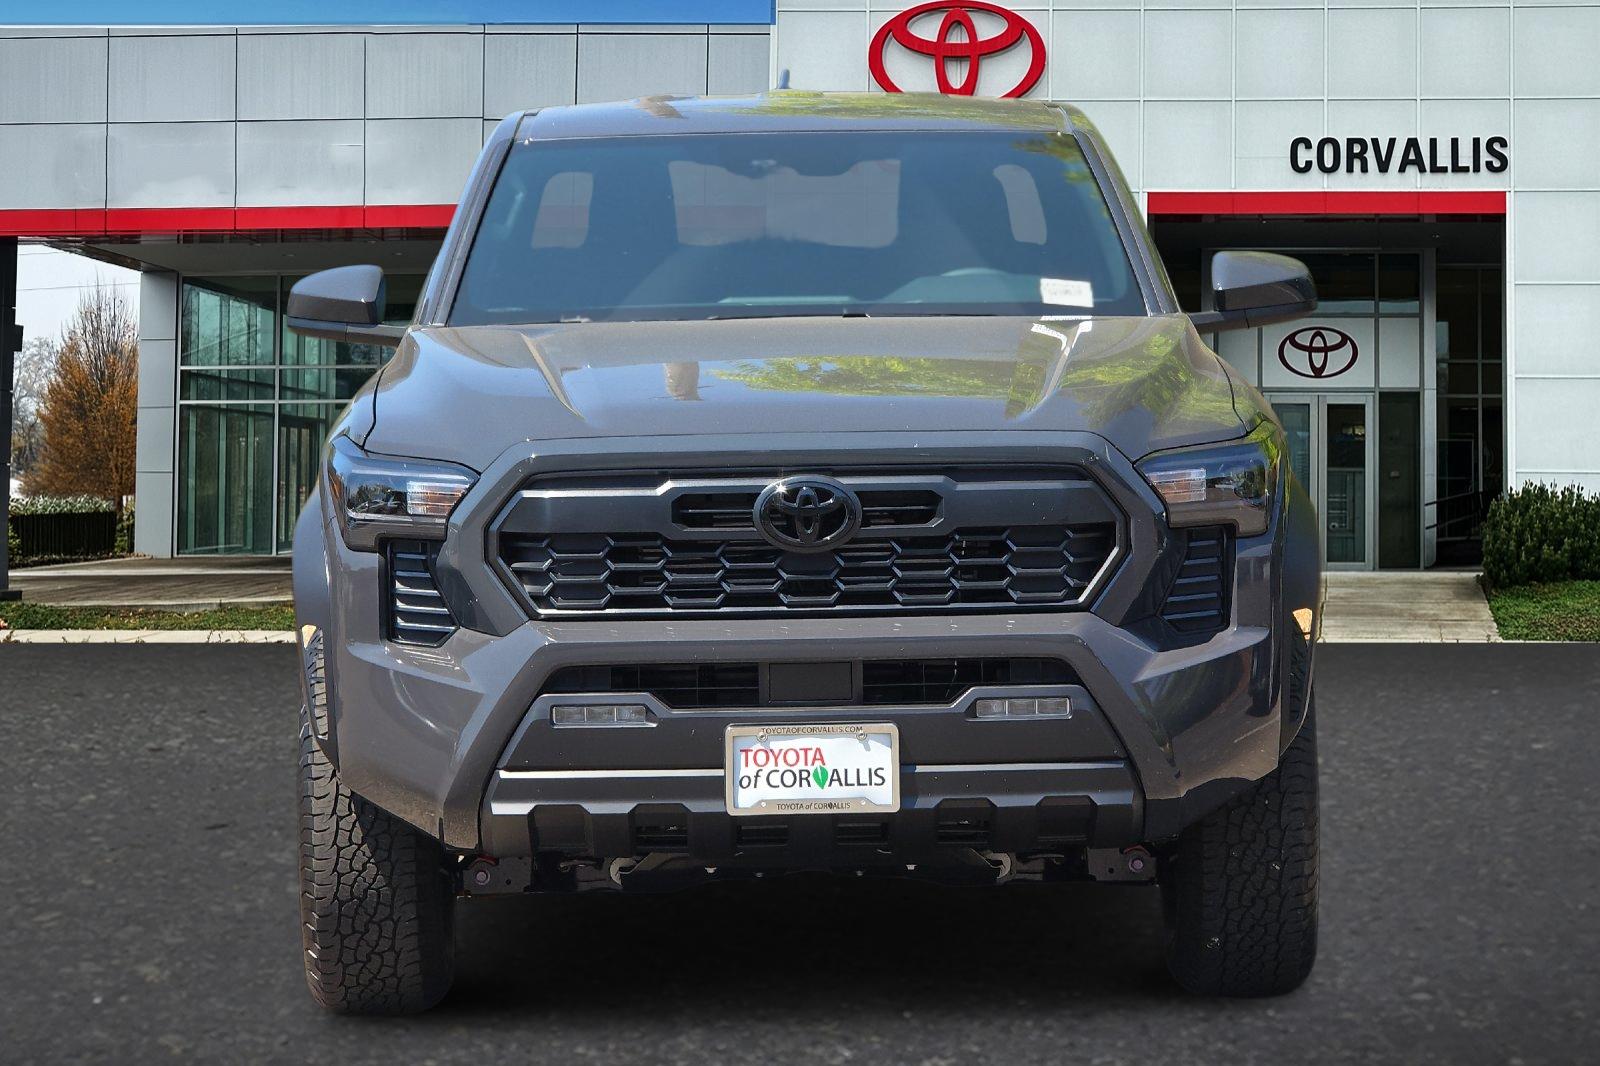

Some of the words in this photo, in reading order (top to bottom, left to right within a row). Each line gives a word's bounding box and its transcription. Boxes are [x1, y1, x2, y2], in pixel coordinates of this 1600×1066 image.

[1290, 136, 1508, 174] CORVALLIS
[739, 747, 826, 768] TOYOTA
[739, 769, 763, 789] of
[766, 766, 886, 789] CORVALLIS
[777, 803, 804, 811] TOYOTA
